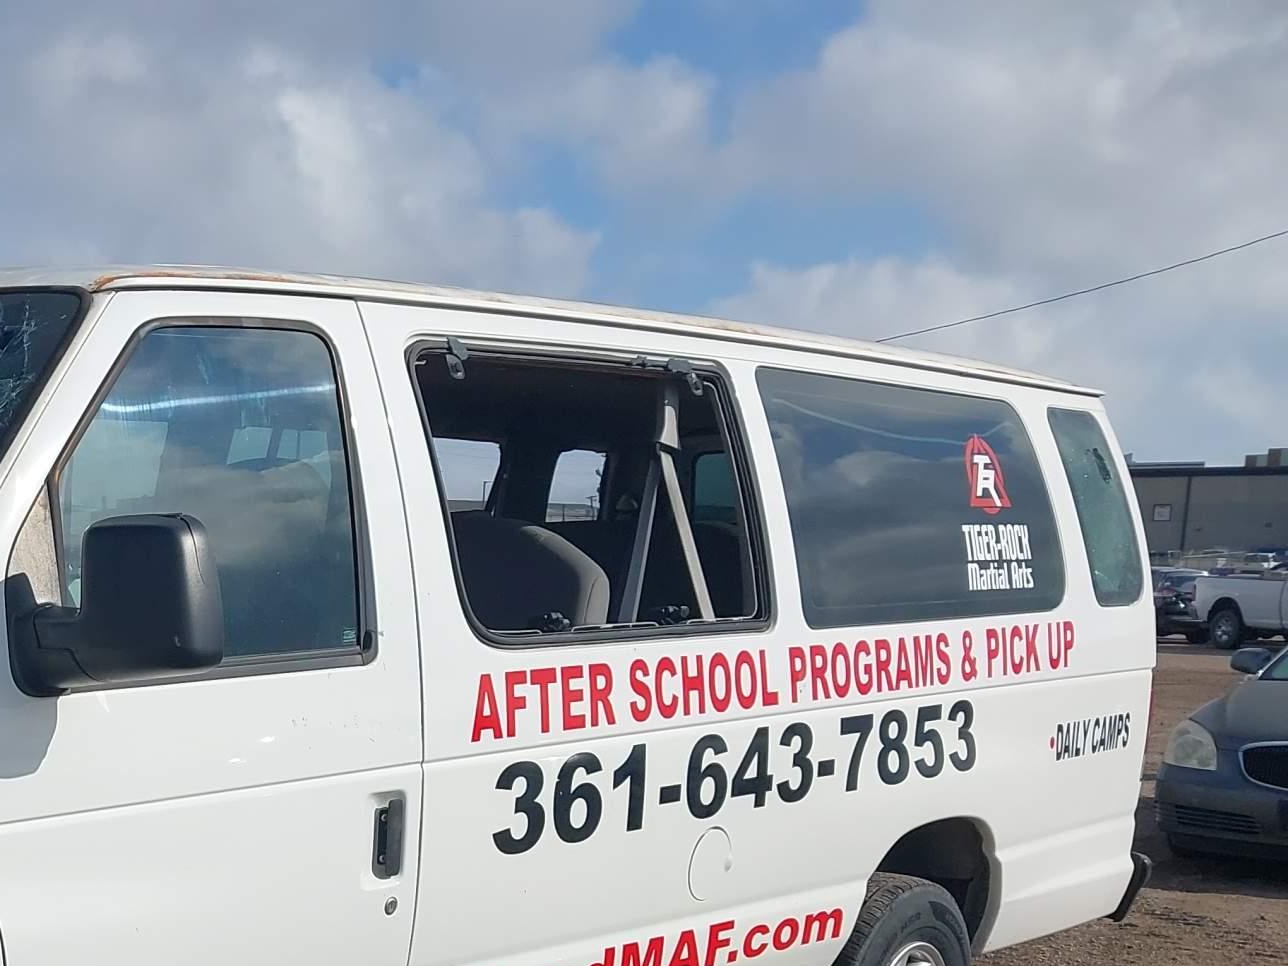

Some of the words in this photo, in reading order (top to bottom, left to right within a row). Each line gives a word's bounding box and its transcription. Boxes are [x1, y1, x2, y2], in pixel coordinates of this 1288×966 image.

[961, 523, 1032, 562] TIGER-ROCK
[967, 563, 1010, 591] Martial
[1011, 562, 1034, 589] Arts
[470, 661, 616, 743] AFTER
[629, 648, 778, 722] SCHOOL
[787, 633, 951, 703] PROGRAMS
[960, 630, 978, 682] &
[985, 624, 1041, 678] PICK
[1047, 620, 1074, 669] UP
[1055, 718, 1091, 761] DAILY
[1091, 712, 1131, 754] CAMPS
[492, 699, 976, 856] 361-643-7853
